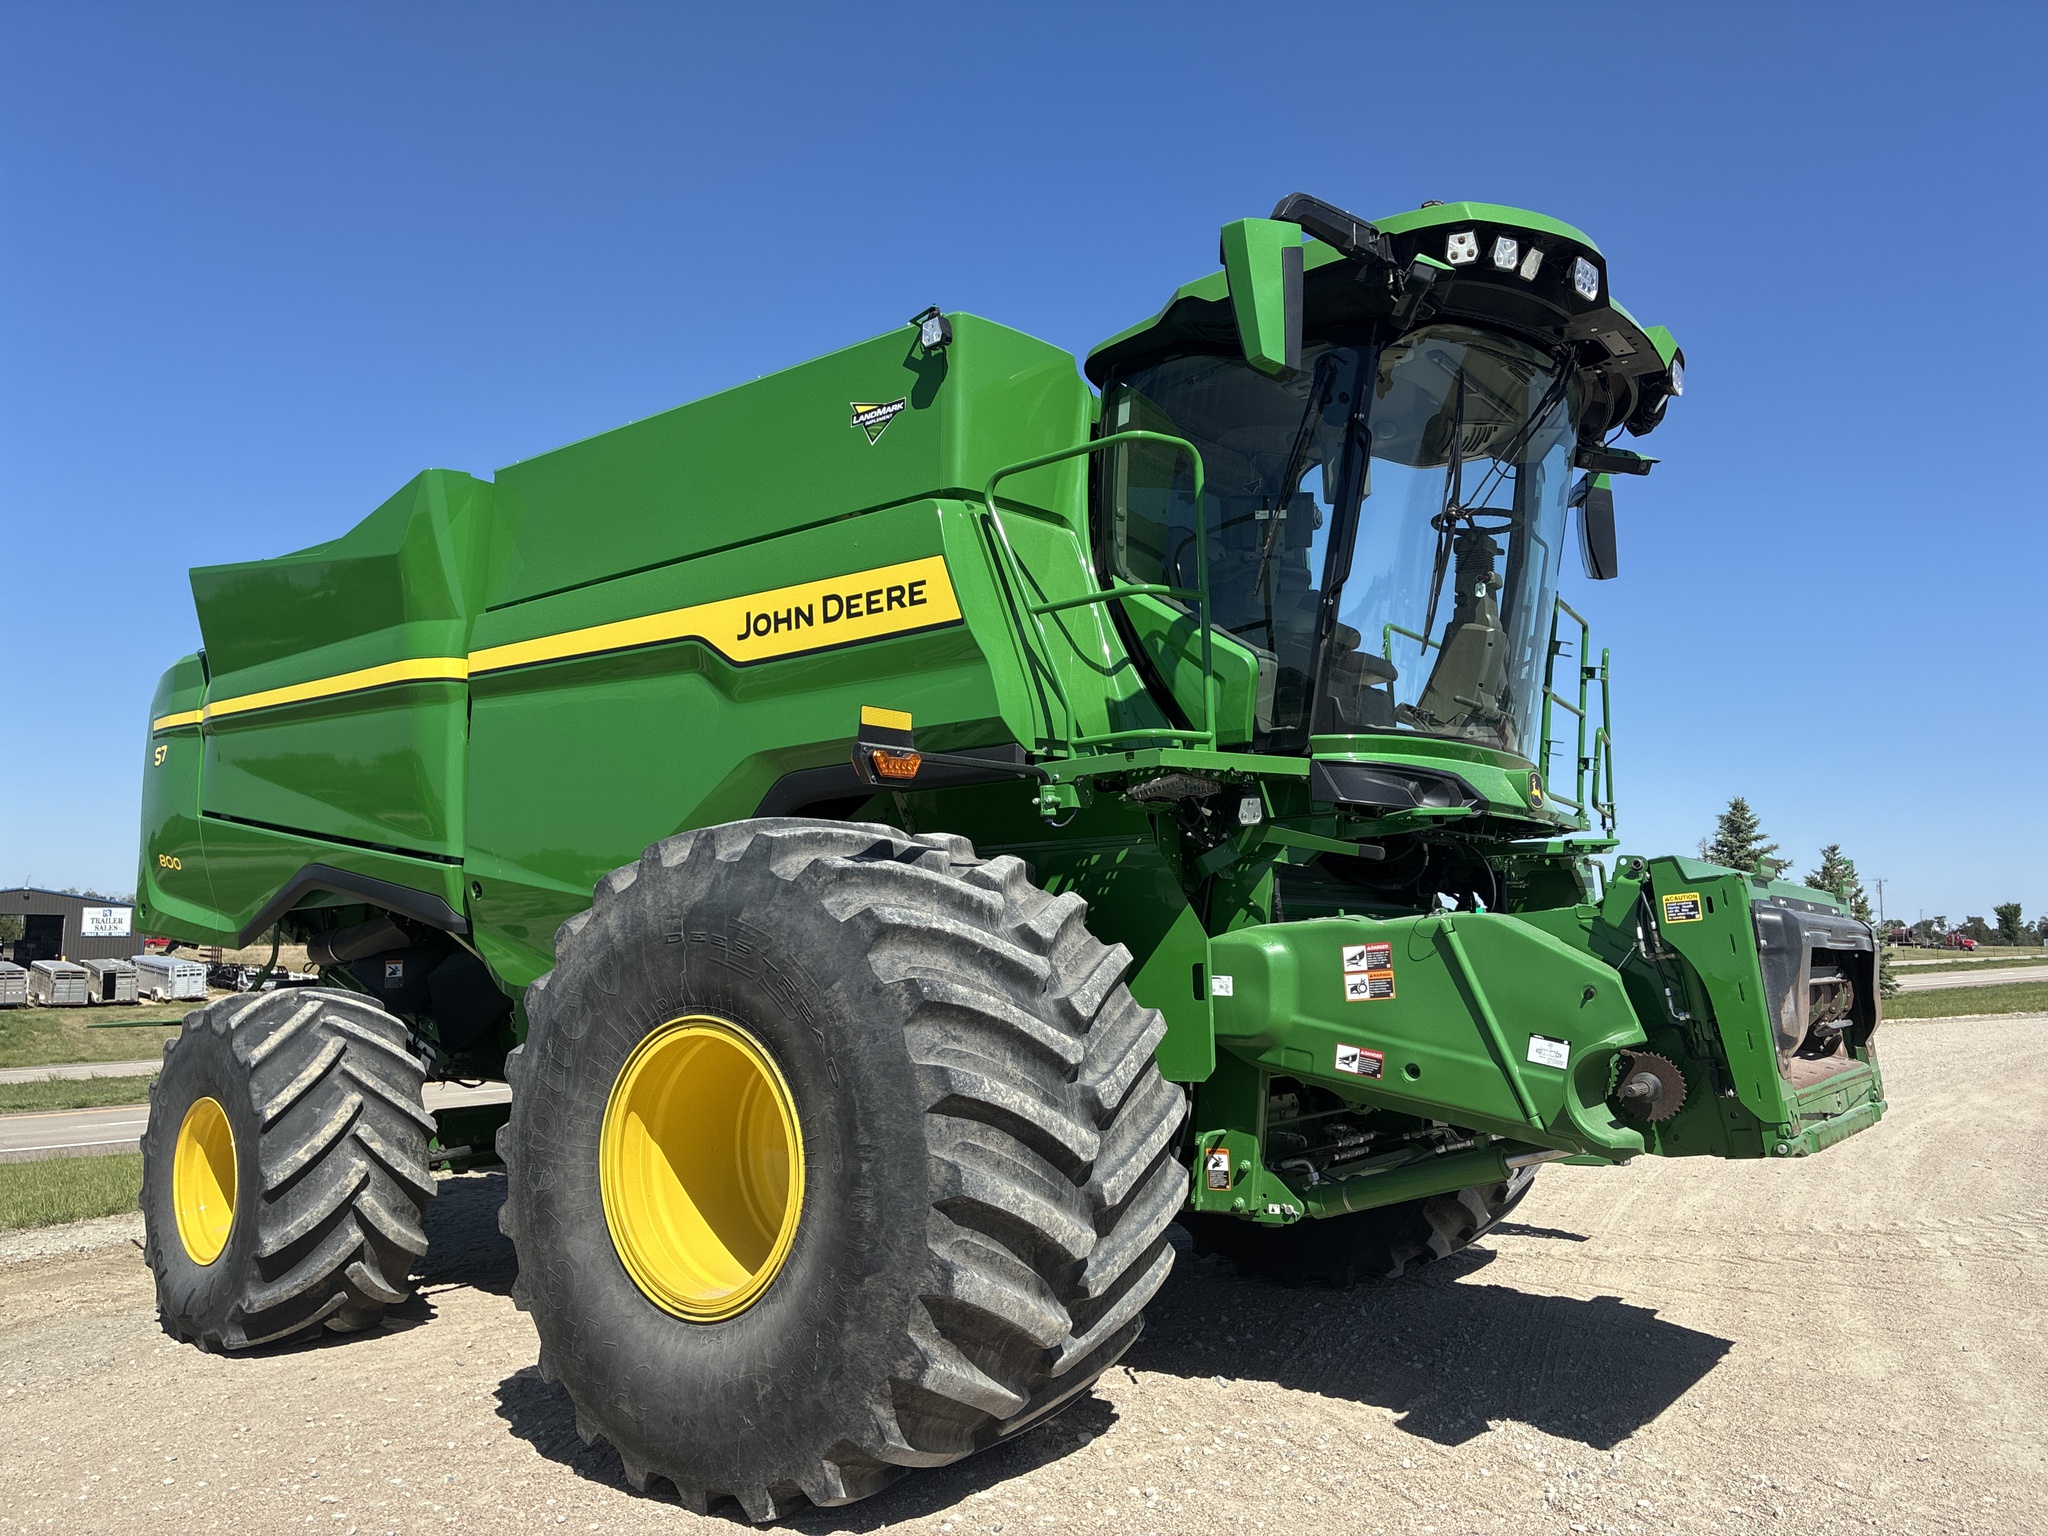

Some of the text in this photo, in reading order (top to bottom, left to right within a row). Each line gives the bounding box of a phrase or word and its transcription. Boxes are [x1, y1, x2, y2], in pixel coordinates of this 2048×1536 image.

[853, 402, 904, 424] LANDMARK
[737, 579, 928, 641] JOHN DEERE
[154, 744, 168, 767] S7
[158, 853, 182, 871] 800
[1669, 894, 1698, 902] CAUTION
[90, 917, 123, 925] TRAILER
[94, 924, 119, 932] SALES
[664, 930, 842, 1089] DEEP TREAD
